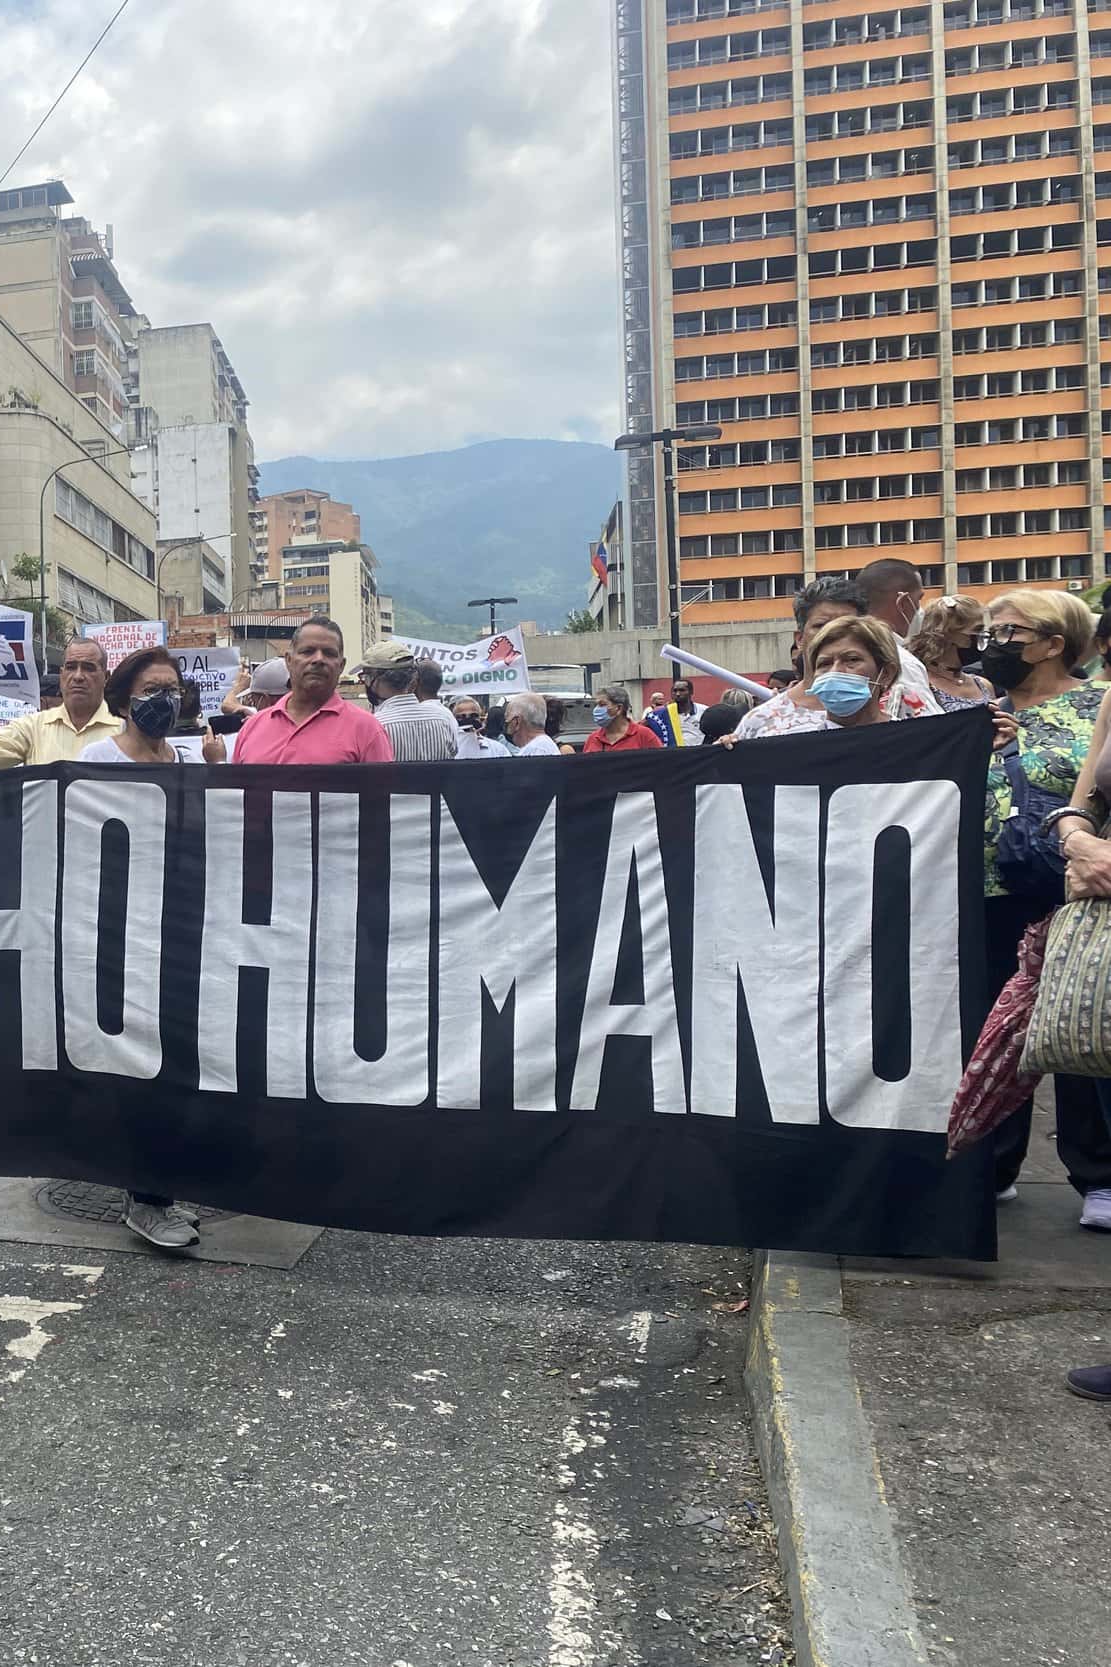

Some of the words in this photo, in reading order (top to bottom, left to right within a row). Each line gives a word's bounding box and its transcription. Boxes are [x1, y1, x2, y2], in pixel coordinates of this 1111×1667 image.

[105, 624, 143, 634] FRENTE
[192, 655, 218, 673] AL
[462, 668, 518, 683] DIGNO
[199, 780, 962, 1132] HUMANO
